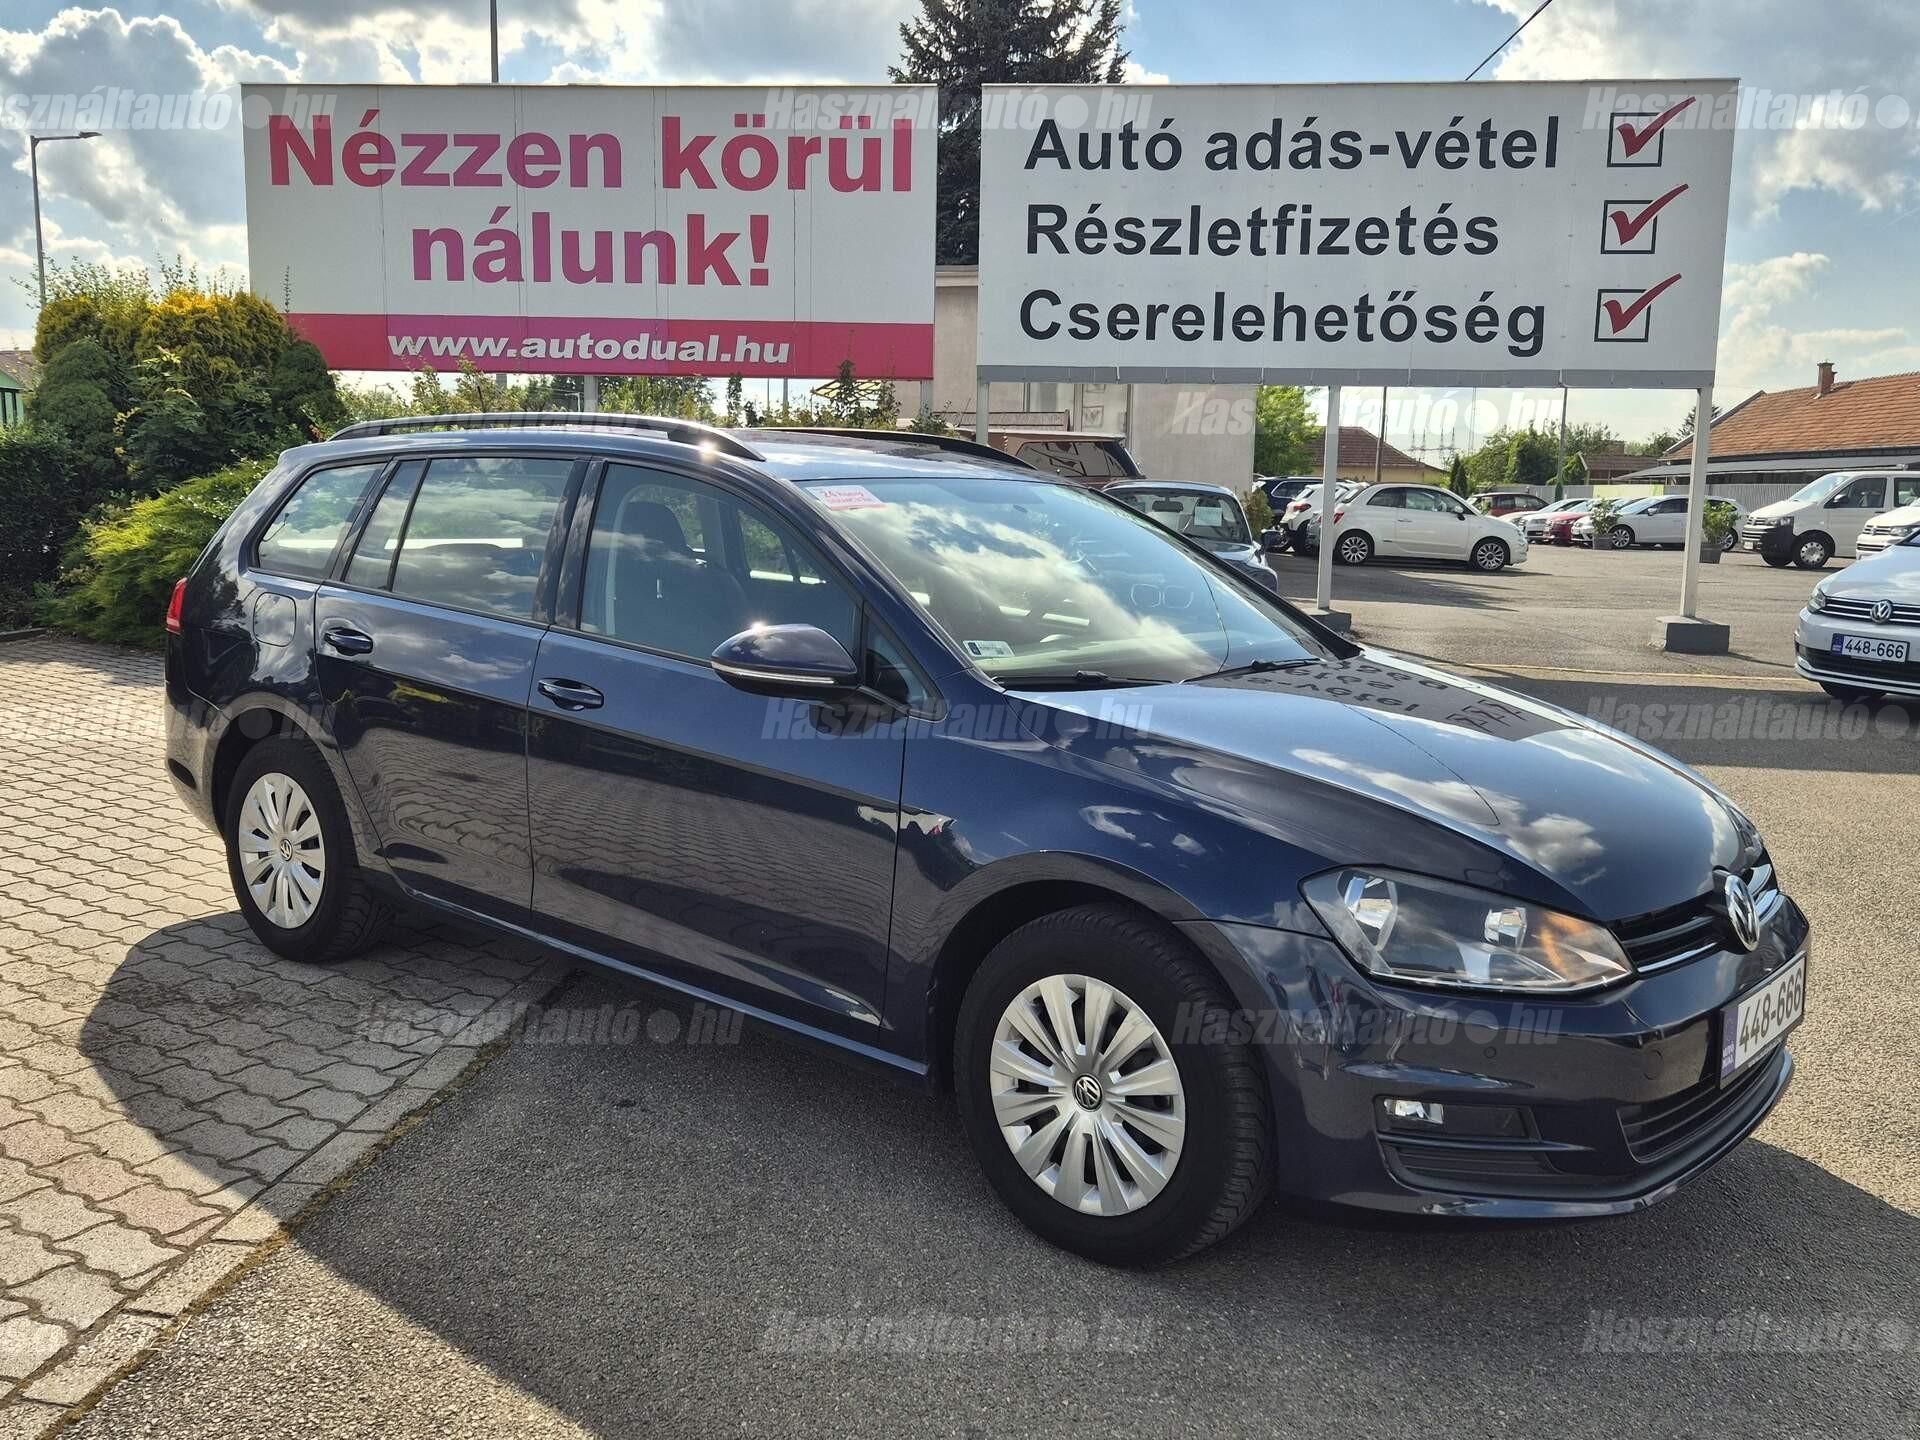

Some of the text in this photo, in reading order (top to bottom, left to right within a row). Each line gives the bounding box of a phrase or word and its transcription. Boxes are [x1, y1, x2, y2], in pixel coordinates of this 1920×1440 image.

[268, 109, 913, 193] Nézzen körül
[1024, 115, 1559, 171] Autó adás-vétel
[412, 206, 769, 287] nálunk!
[1027, 202, 1499, 257] Részletfizetés
[387, 332, 790, 364] www.autodual.hu
[1020, 289, 1545, 358] Cserelehetőség
[1844, 640, 1904, 660] 448-666
[1738, 967, 1802, 1054] 448-666
